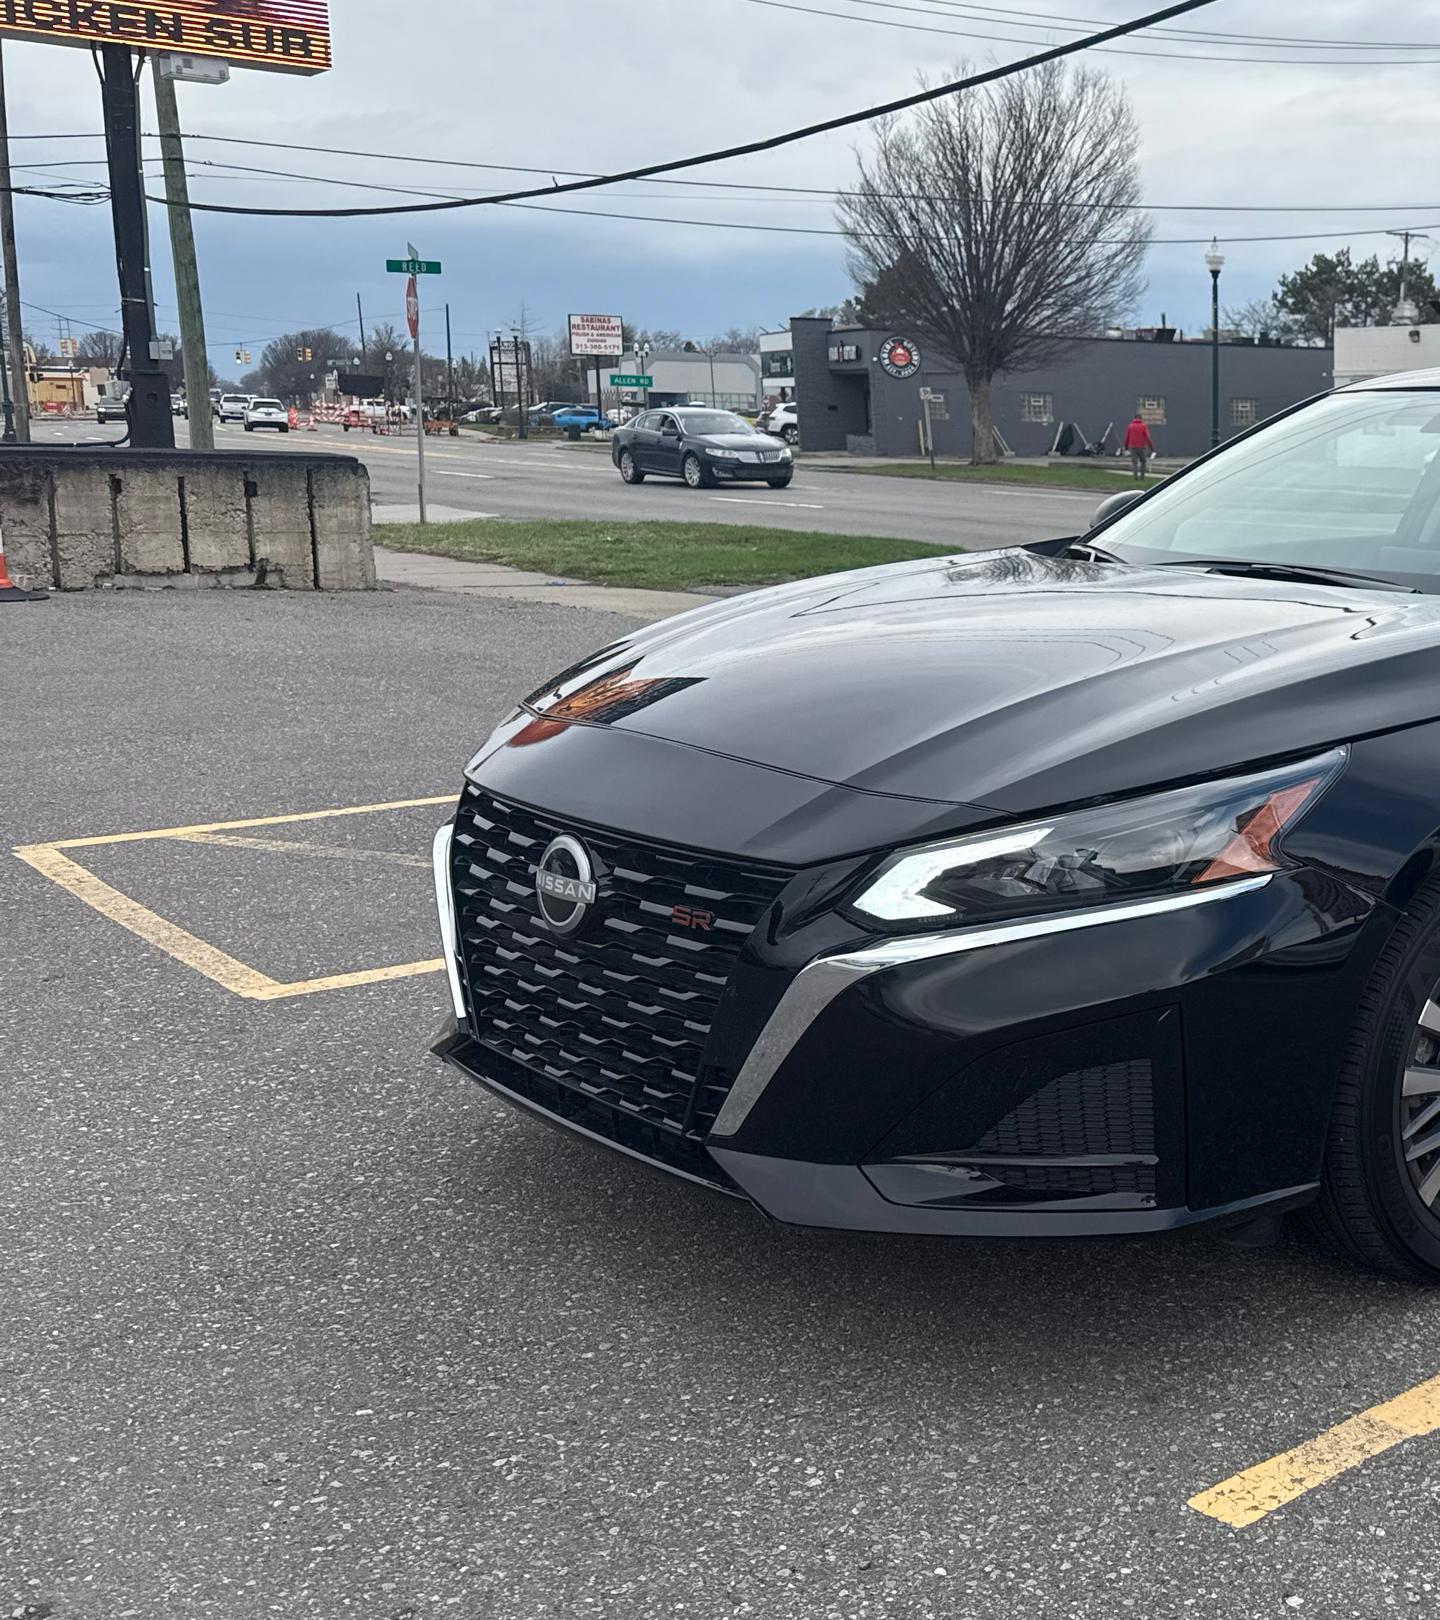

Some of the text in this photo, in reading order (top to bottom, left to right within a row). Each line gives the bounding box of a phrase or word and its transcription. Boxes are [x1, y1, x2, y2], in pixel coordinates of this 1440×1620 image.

[204, 19, 313, 58] SUB
[402, 261, 427, 272] REED
[571, 324, 620, 332] RESTAURANT
[580, 316, 611, 324] SABINAS
[536, 870, 592, 900] NISSAN
[671, 904, 715, 931] SR
